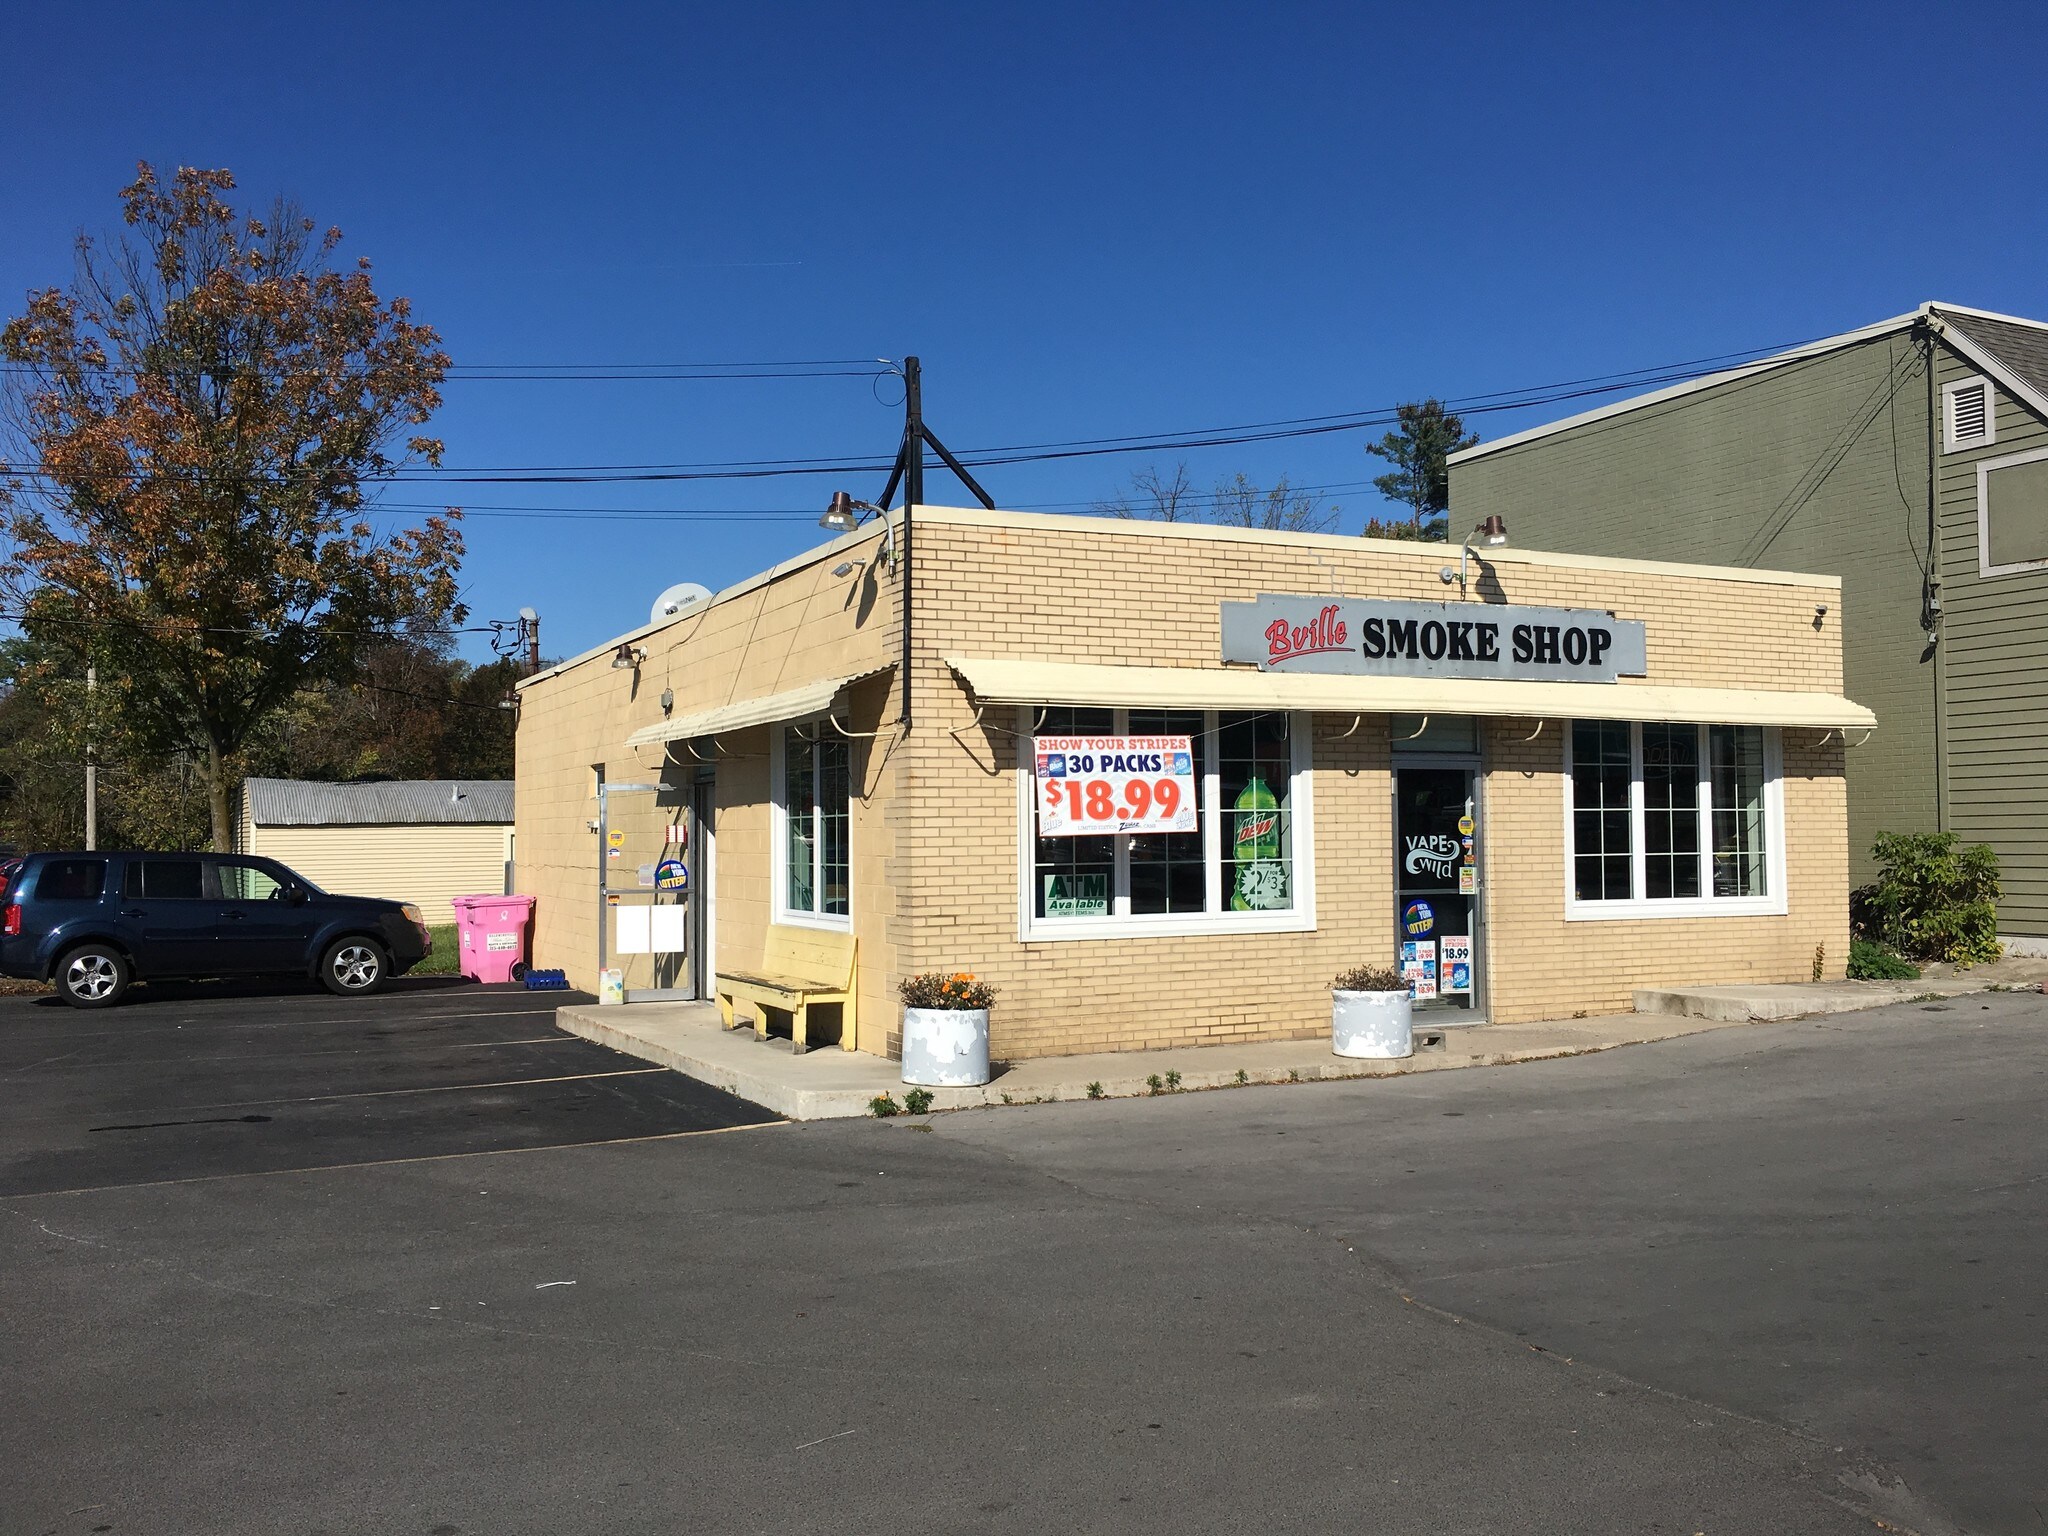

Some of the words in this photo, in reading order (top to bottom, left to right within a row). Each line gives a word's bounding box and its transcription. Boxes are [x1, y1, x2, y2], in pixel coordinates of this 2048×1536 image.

[1265, 605, 1347, 655] Bville
[1362, 618, 1500, 662] SMOKE
[1511, 624, 1612, 666] SHOP
[1038, 739, 1084, 751] SHOW
[1085, 739, 1125, 750] YOUR
[1129, 738, 1187, 750] STRIPES
[1068, 755, 1094, 773] 30
[1100, 754, 1162, 773] PACKS
[1045, 778, 1182, 822] $18.99
[1237, 814, 1278, 844] DEW
[1405, 834, 1448, 852] VAPE
[658, 875, 687, 889] LOTTERY
[1048, 875, 1105, 898] ATM
[1406, 918, 1434, 934] LOTTERY
[1442, 948, 1469, 959] $18.99
